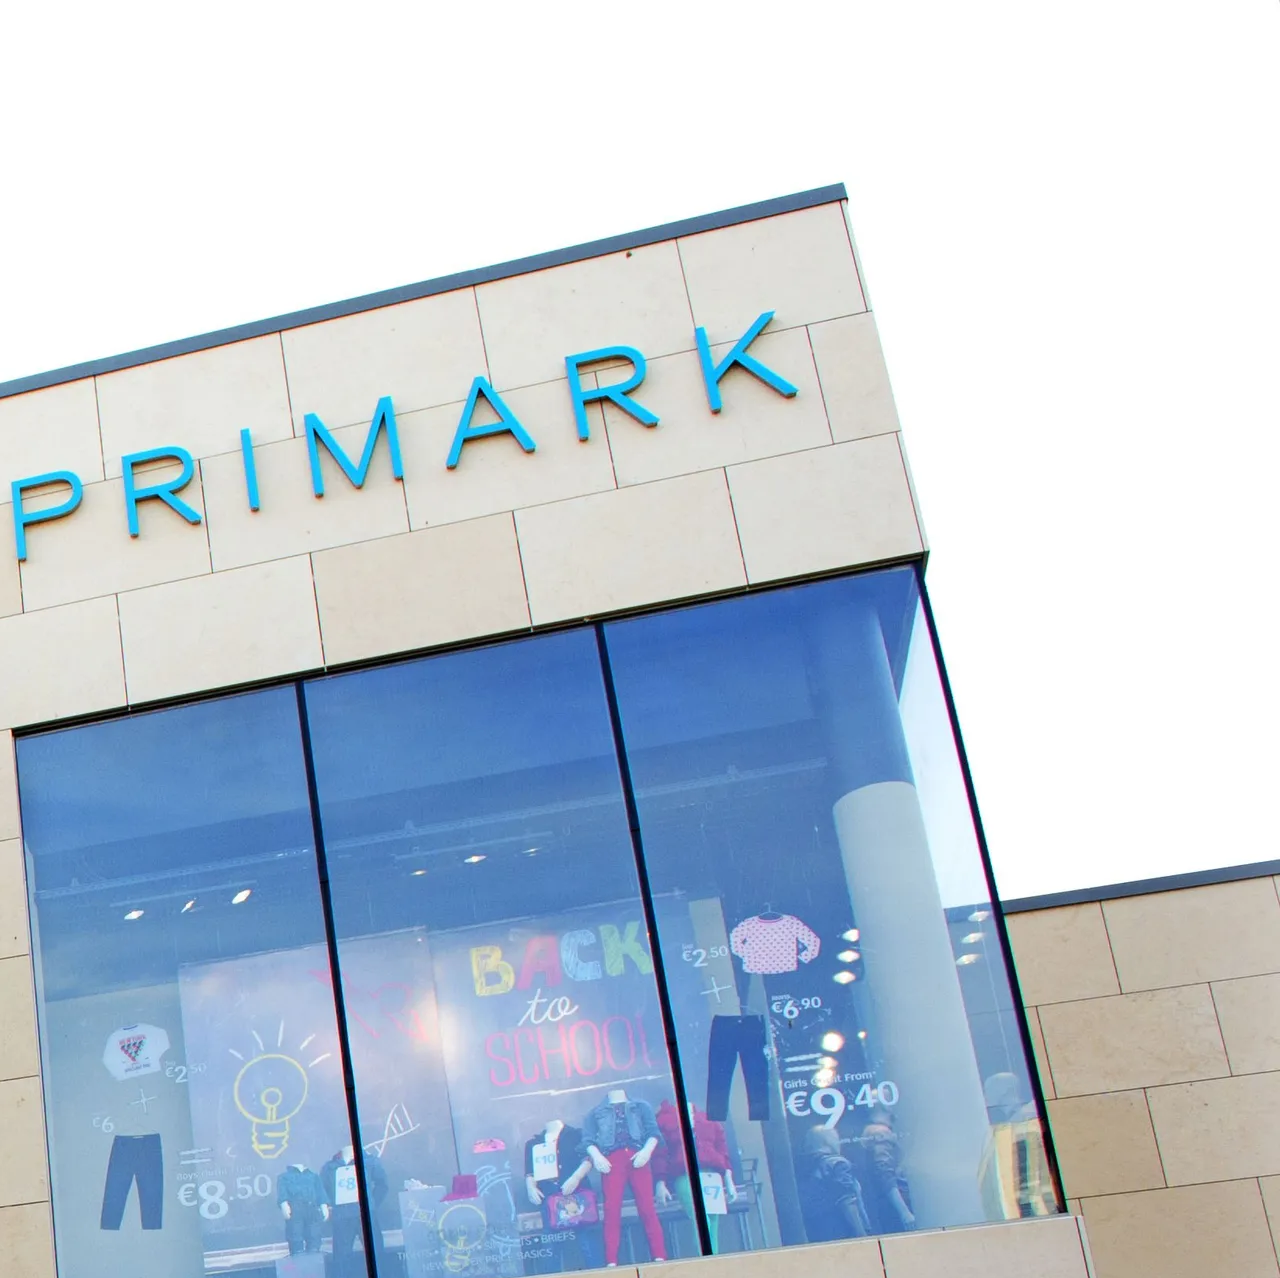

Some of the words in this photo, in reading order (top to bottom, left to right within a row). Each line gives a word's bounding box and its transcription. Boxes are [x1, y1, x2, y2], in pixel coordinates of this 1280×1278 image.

[11, 310, 799, 562] PRIMARK
[470, 921, 654, 997] BACK
[682, 945, 729, 967] €2.50
[518, 988, 579, 1026] to
[771, 997, 821, 1019] €6.90
[484, 1013, 664, 1087] SCHOOL
[784, 1076, 807, 1089] Girls
[787, 1081, 899, 1130] €9.40
[93, 1117, 114, 1133] €6
[177, 1174, 272, 1219] €8.50
[541, 1231, 576, 1243] BRIEFS
